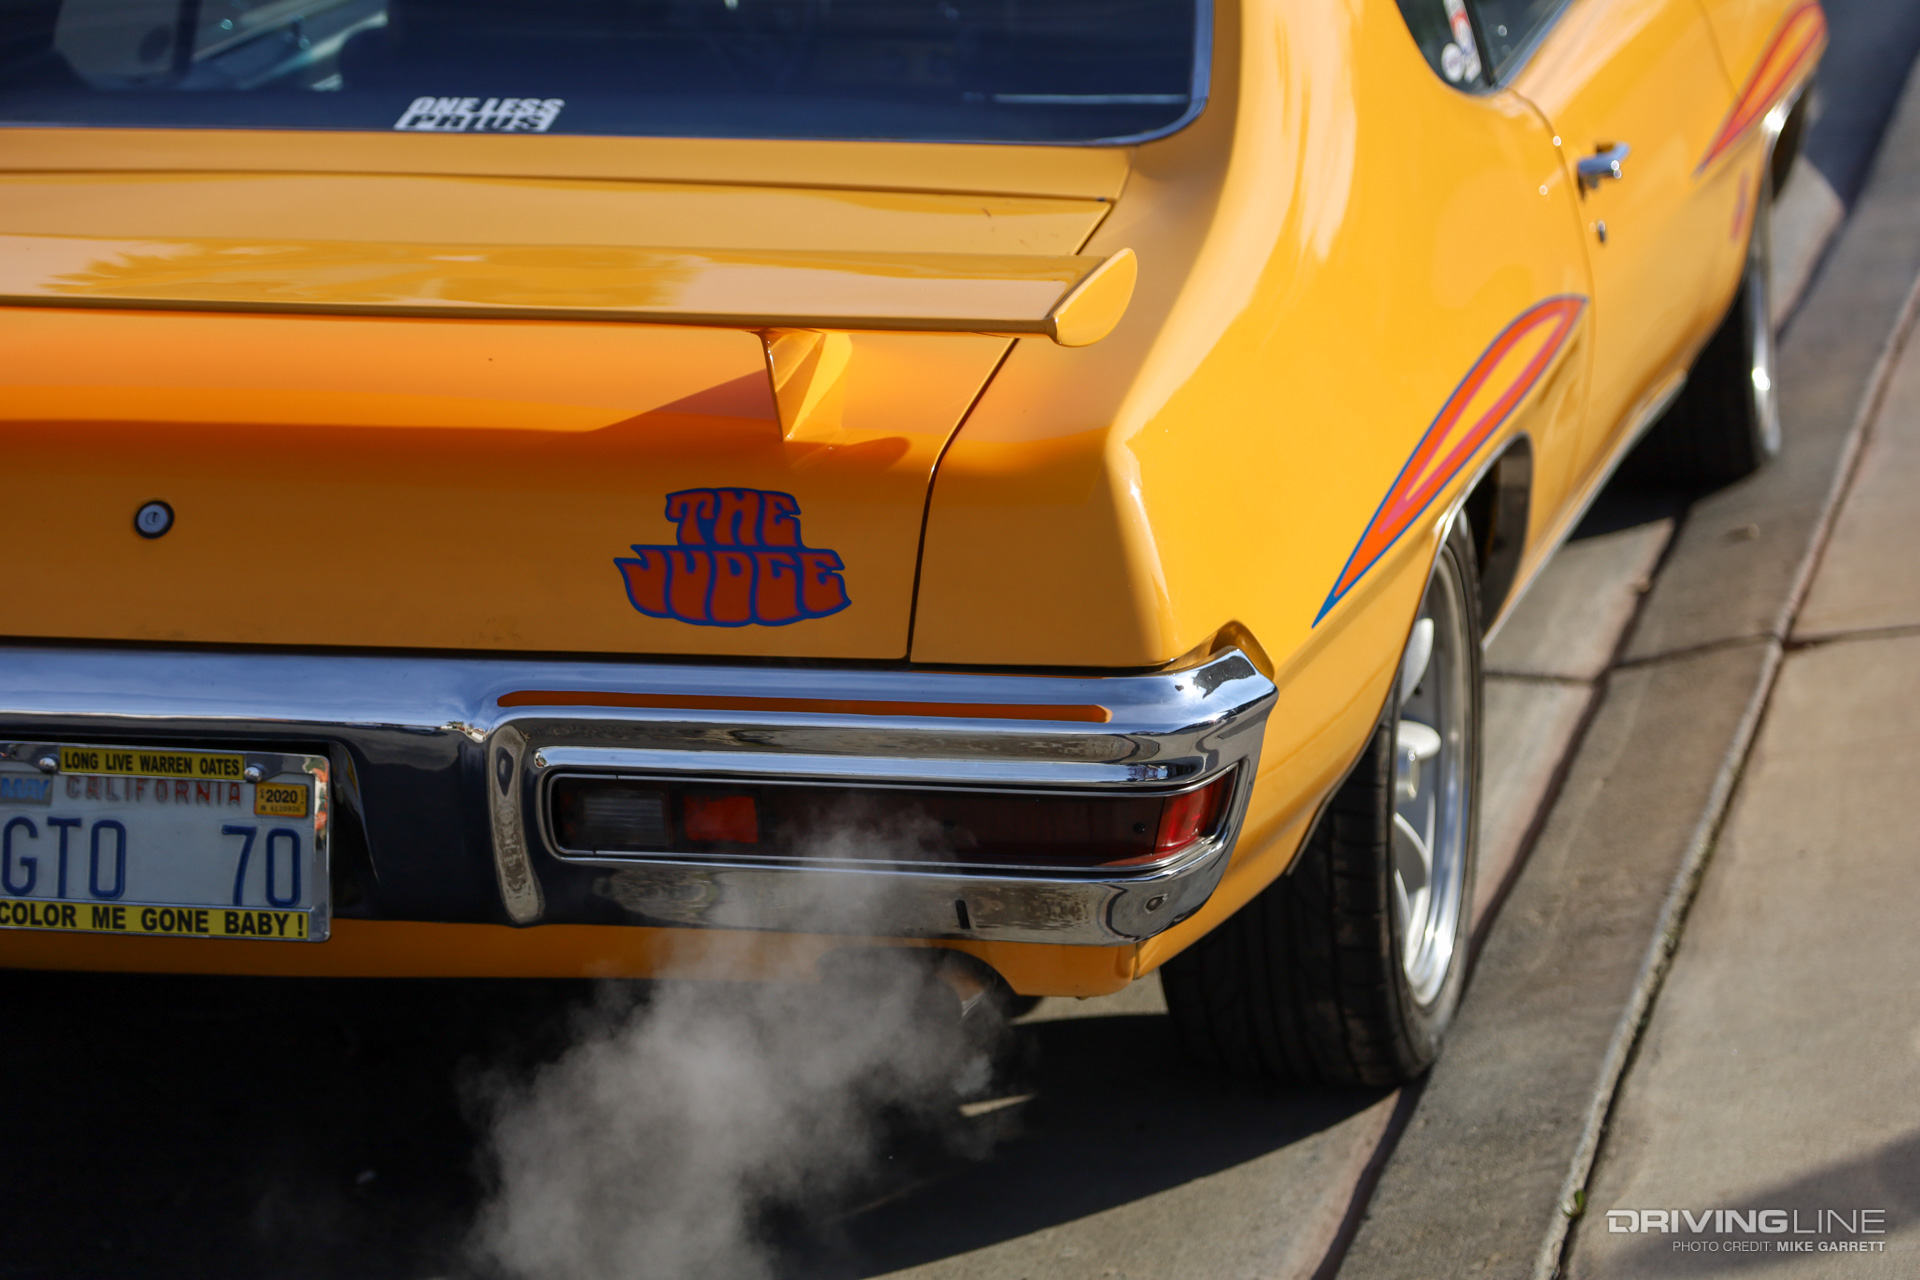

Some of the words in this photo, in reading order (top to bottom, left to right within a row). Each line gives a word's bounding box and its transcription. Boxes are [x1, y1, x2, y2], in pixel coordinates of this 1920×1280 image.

[408, 96, 480, 114] ONE
[478, 97, 565, 115] LESS
[665, 487, 801, 548] THE
[613, 545, 852, 627] JUDGE
[64, 751, 98, 770] LONG
[105, 753, 133, 772] LIVE
[140, 754, 193, 775] WARREN
[199, 757, 240, 777] OATES
[1, 777, 49, 800] MAY
[66, 776, 241, 806] CALIFORNIA
[265, 789, 298, 804] 2020
[1, 816, 126, 899] GTO
[221, 824, 301, 908] 70
[0, 902, 77, 928] COLOR
[92, 906, 126, 930] ME
[141, 907, 209, 933] GONE
